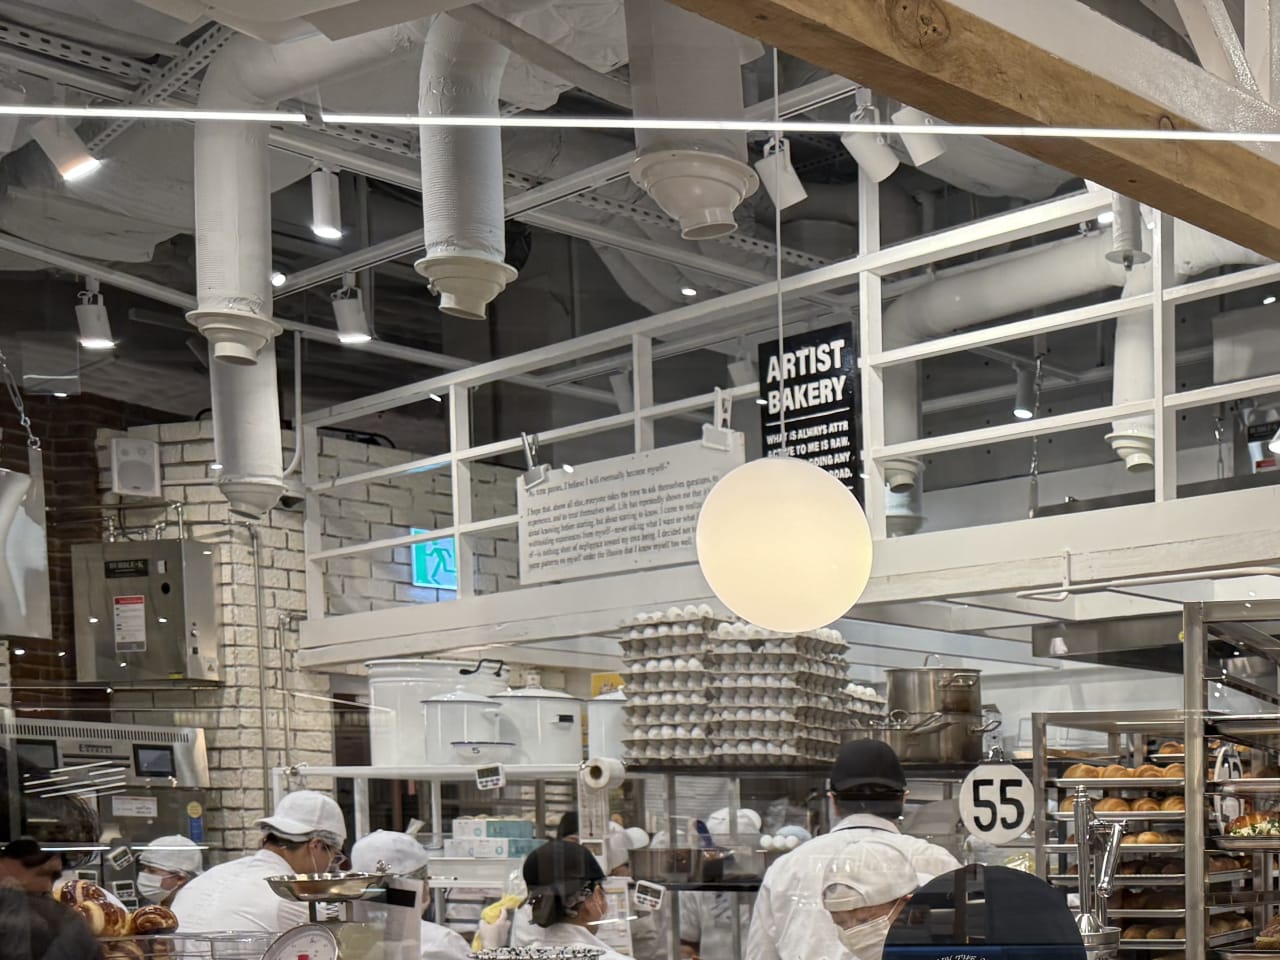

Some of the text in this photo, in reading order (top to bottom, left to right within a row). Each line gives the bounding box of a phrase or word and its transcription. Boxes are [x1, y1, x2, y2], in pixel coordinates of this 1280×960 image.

[767, 339, 845, 384] ARTIST
[768, 375, 846, 415] BAKERY
[789, 430, 797, 440] IS
[797, 423, 828, 439] ALWAYS
[796, 444, 807, 456] TO
[807, 442, 820, 453] ME
[820, 440, 829, 450] IS
[834, 452, 851, 463] ANY
[972, 779, 1025, 832] 55
